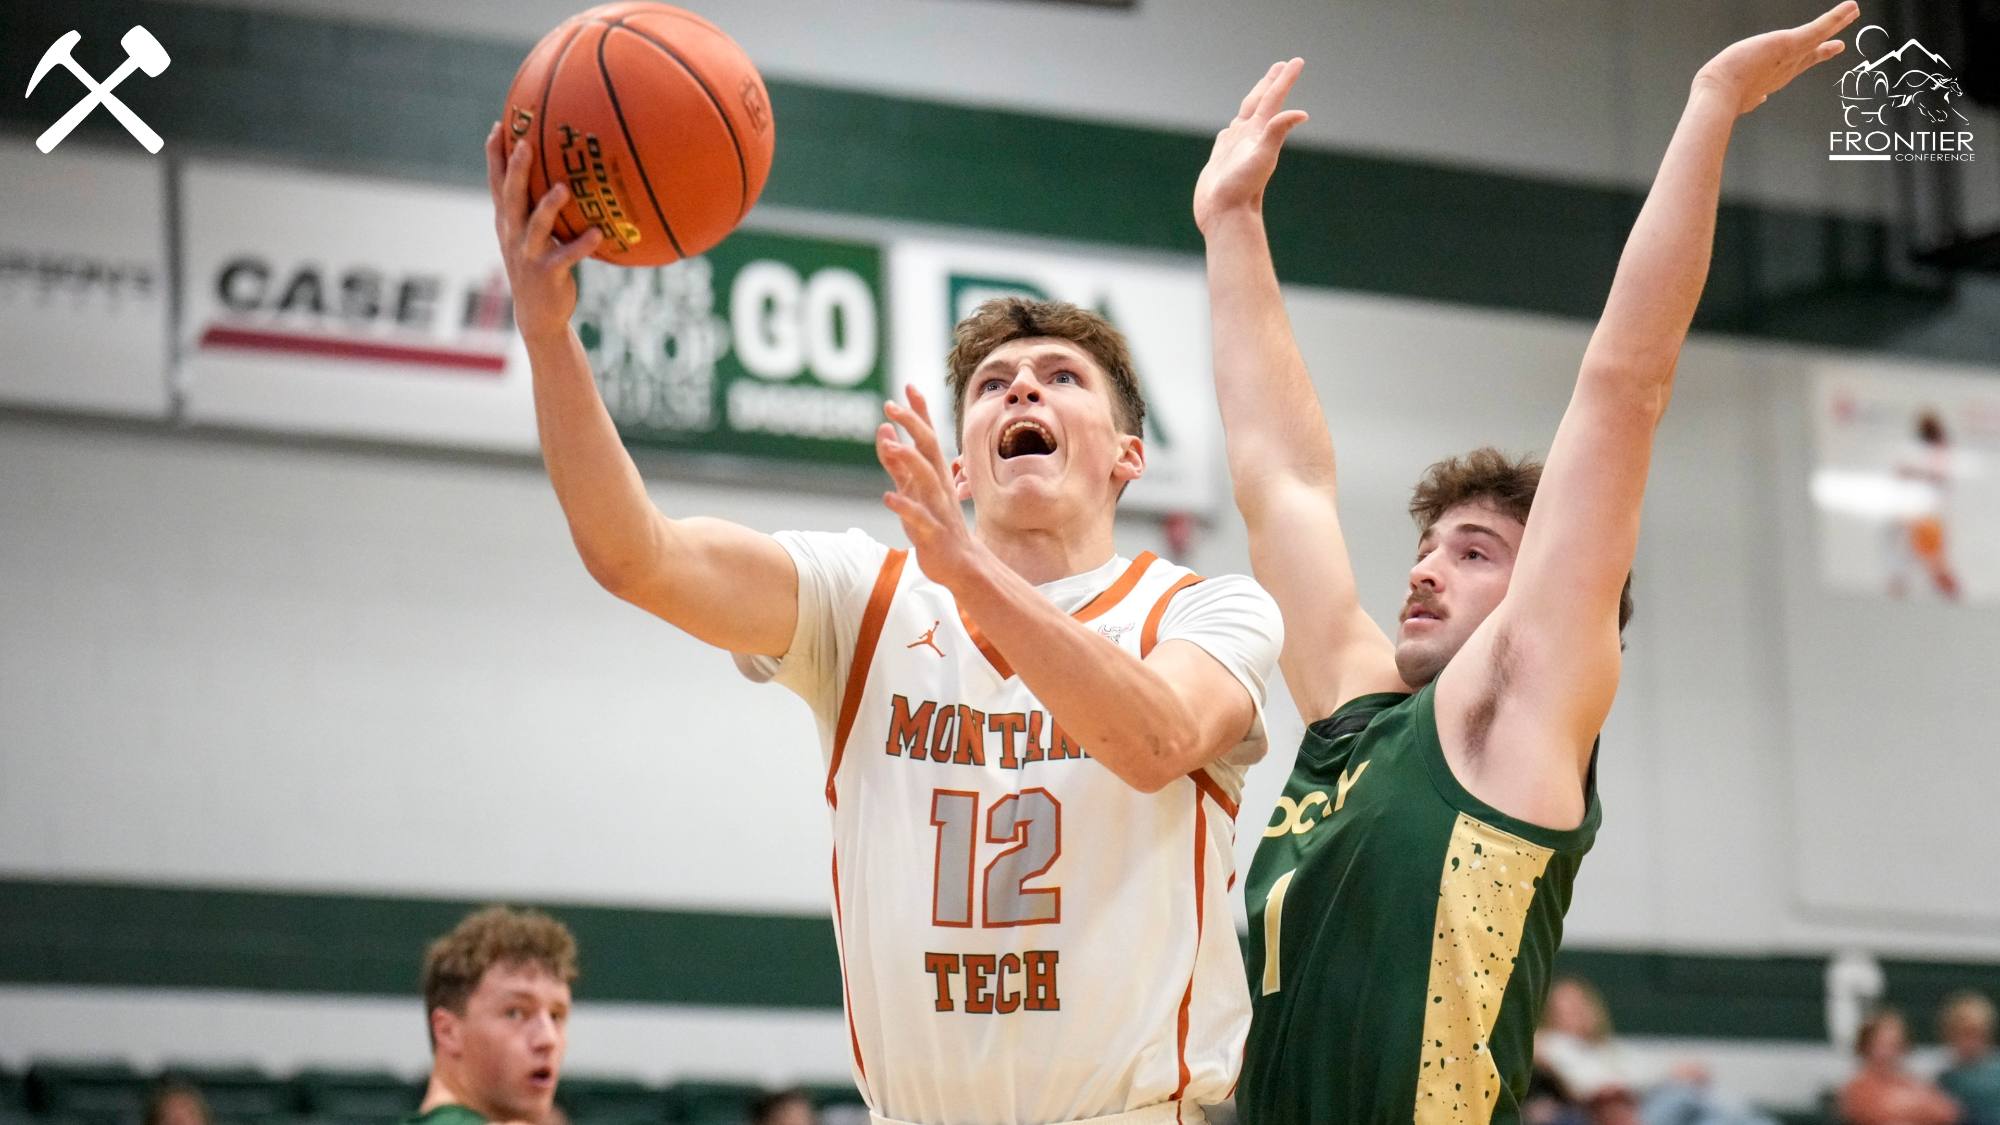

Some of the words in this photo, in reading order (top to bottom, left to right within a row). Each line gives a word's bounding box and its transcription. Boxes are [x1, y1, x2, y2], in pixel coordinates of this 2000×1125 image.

[217, 255, 441, 326] CASE
[731, 260, 878, 385] GO
[885, 694, 1092, 770] MONTAN
[930, 786, 1061, 929] 12
[1262, 867, 1297, 996] 1
[925, 950, 1060, 1015] TECH
